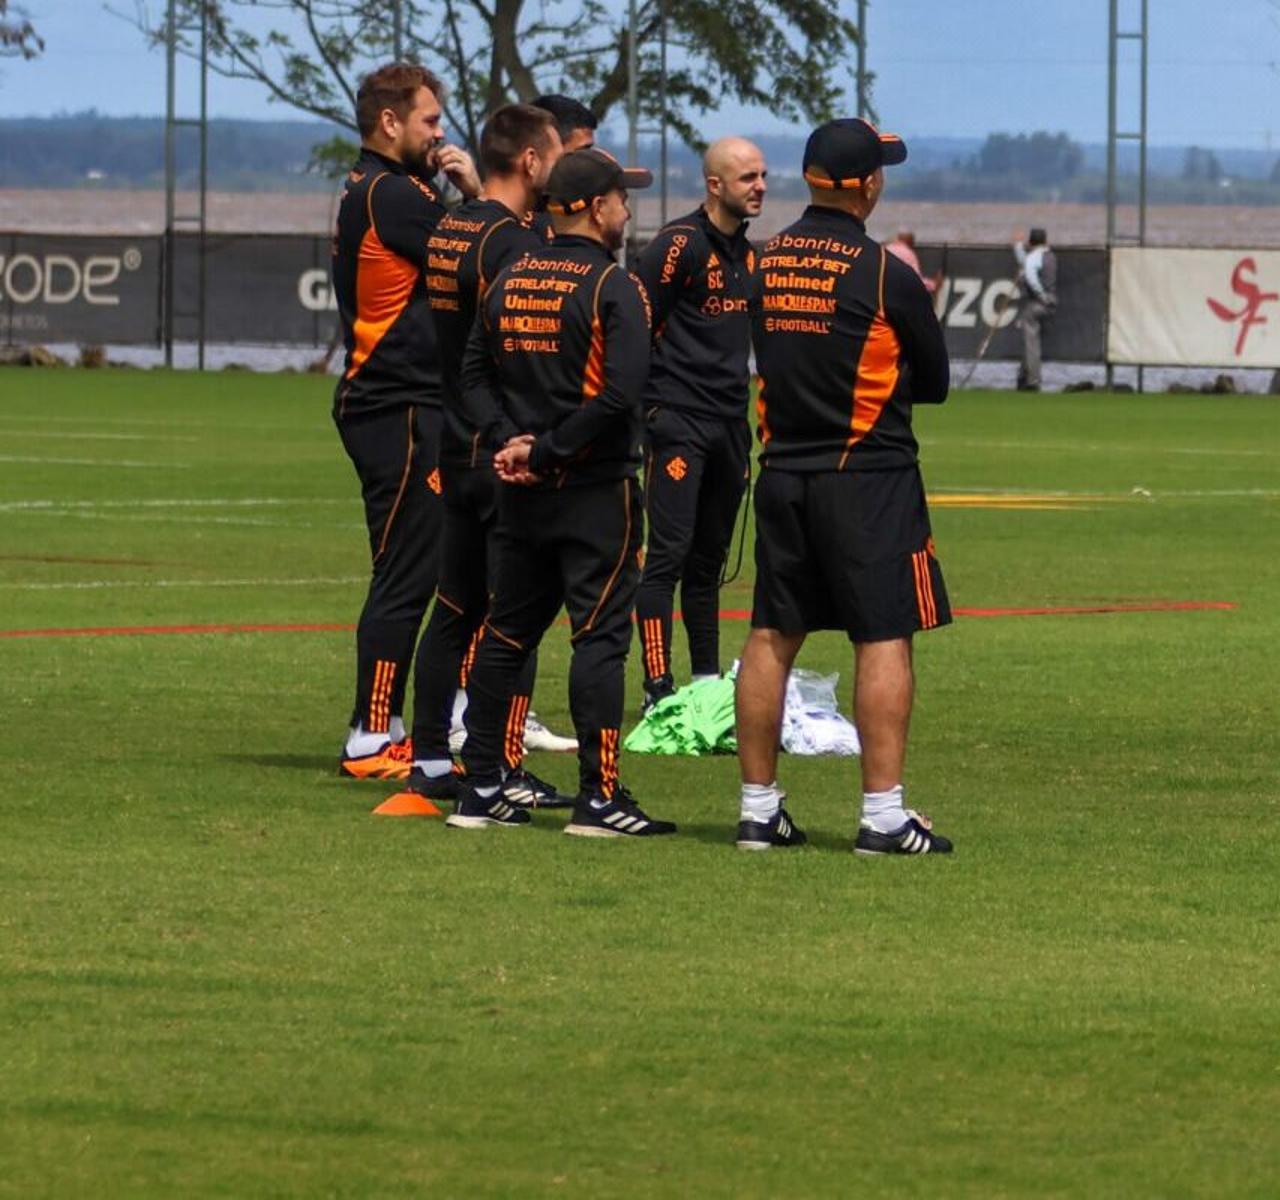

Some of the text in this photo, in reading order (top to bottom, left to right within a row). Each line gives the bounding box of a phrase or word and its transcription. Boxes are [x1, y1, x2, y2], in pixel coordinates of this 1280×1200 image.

[782, 235, 862, 258] banrisul
[528, 259, 592, 276] banrisul
[760, 256, 851, 275] ESTRELA BET
[765, 273, 836, 292] Unimed
[505, 294, 563, 311] Unimed
